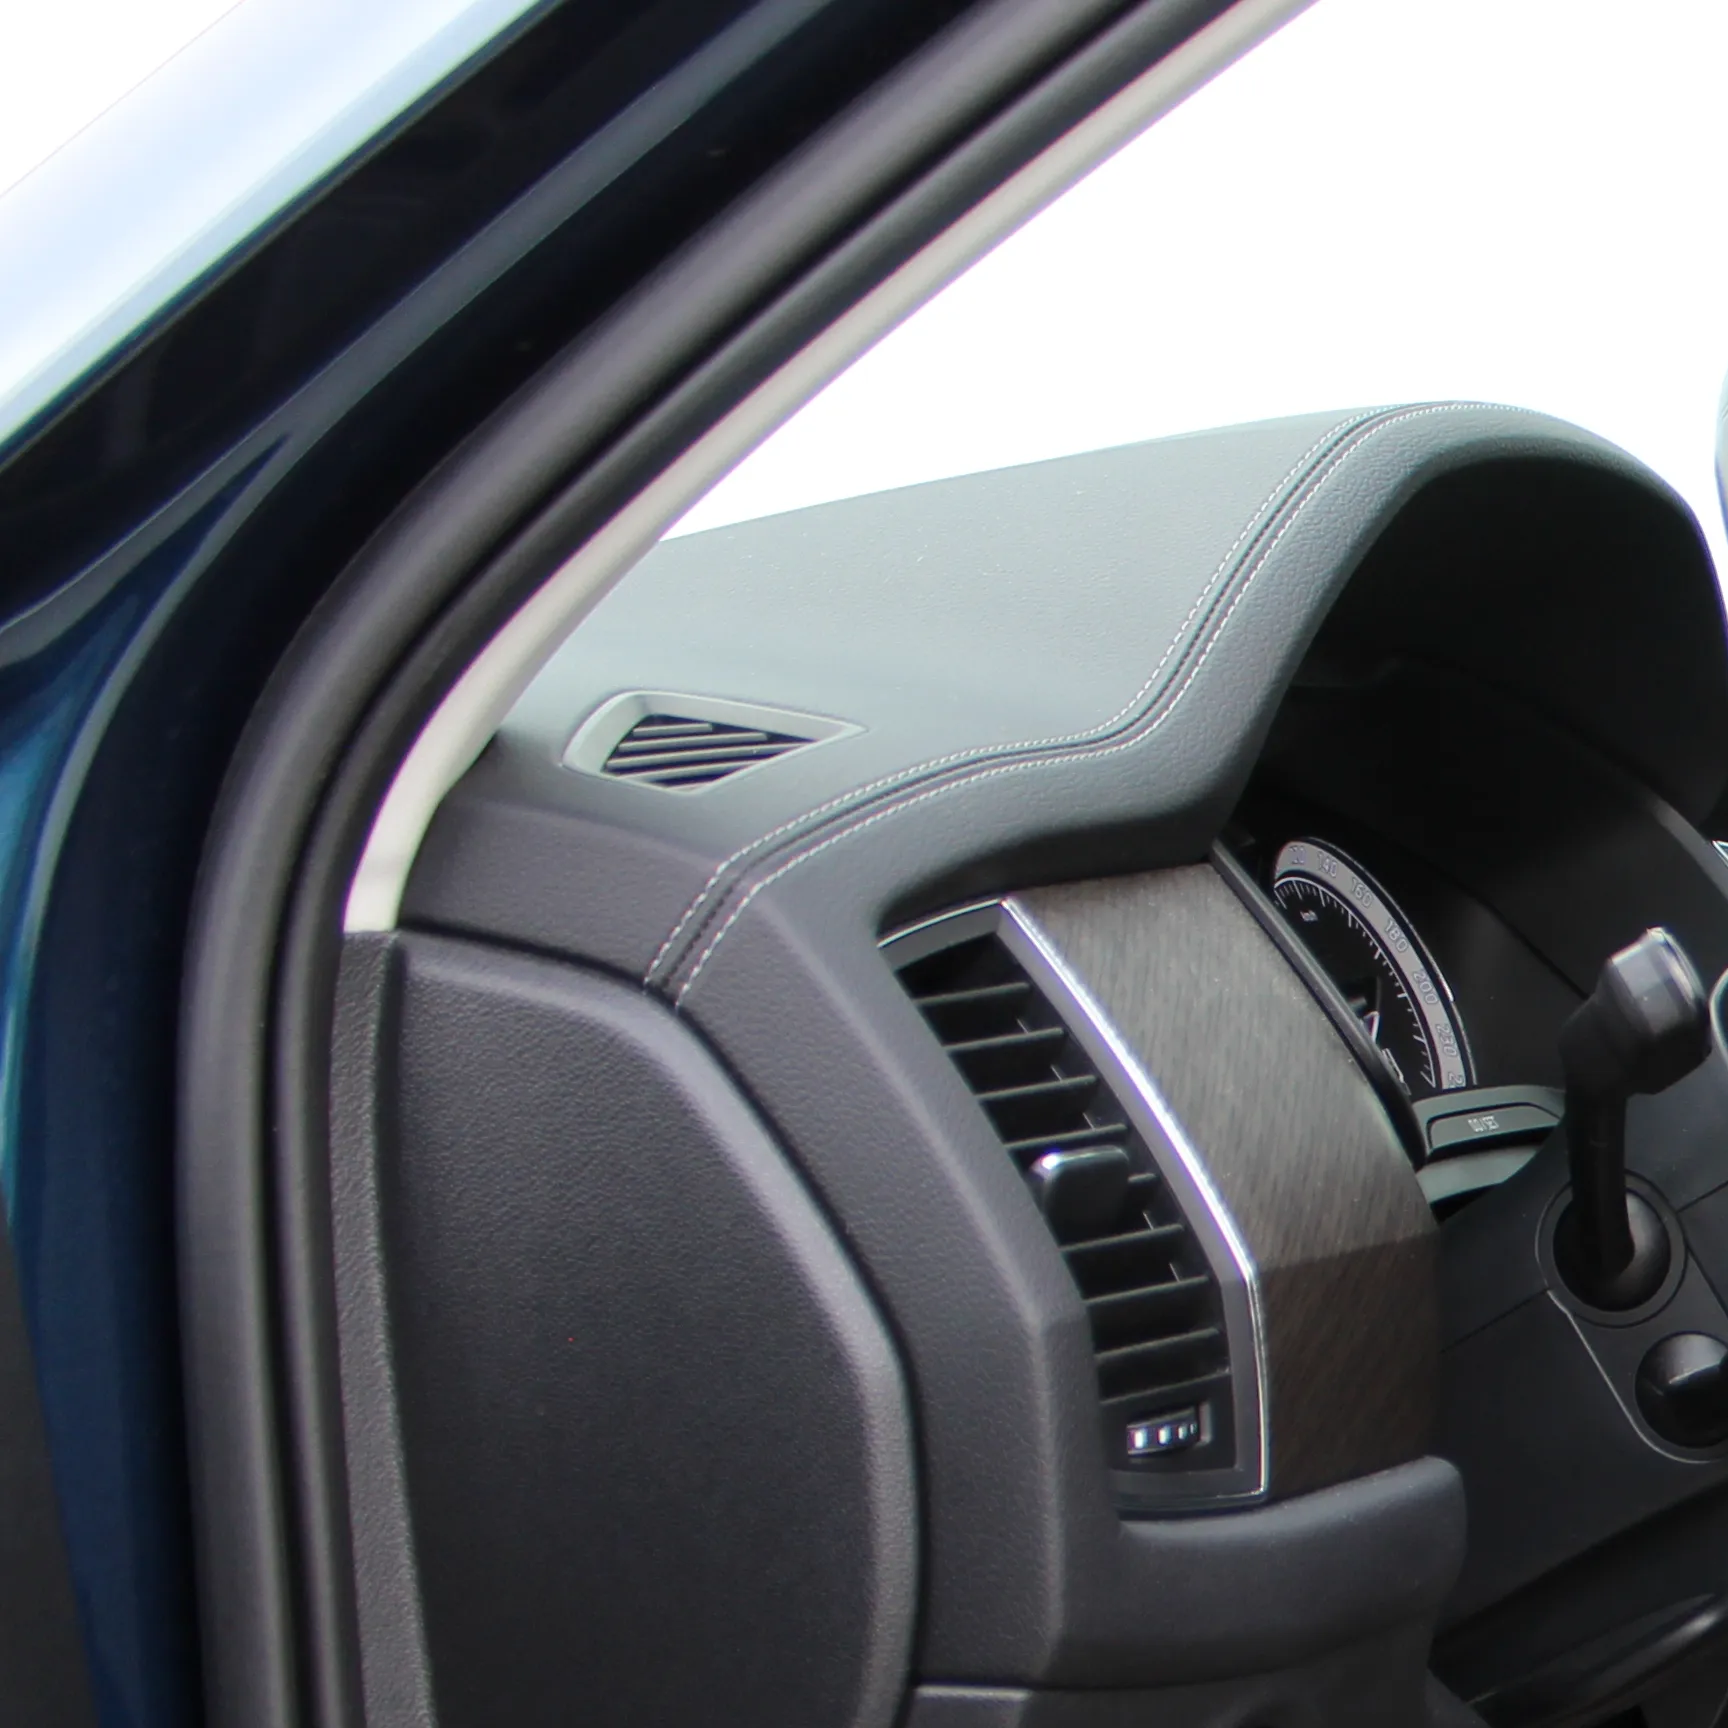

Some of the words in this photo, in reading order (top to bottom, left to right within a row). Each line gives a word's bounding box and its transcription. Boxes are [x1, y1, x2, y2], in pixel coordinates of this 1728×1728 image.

[1316, 850, 1338, 878] 140
[1350, 875, 1374, 909] 160
[1384, 918, 1410, 953] 180
[1412, 968, 1440, 1004] 200
